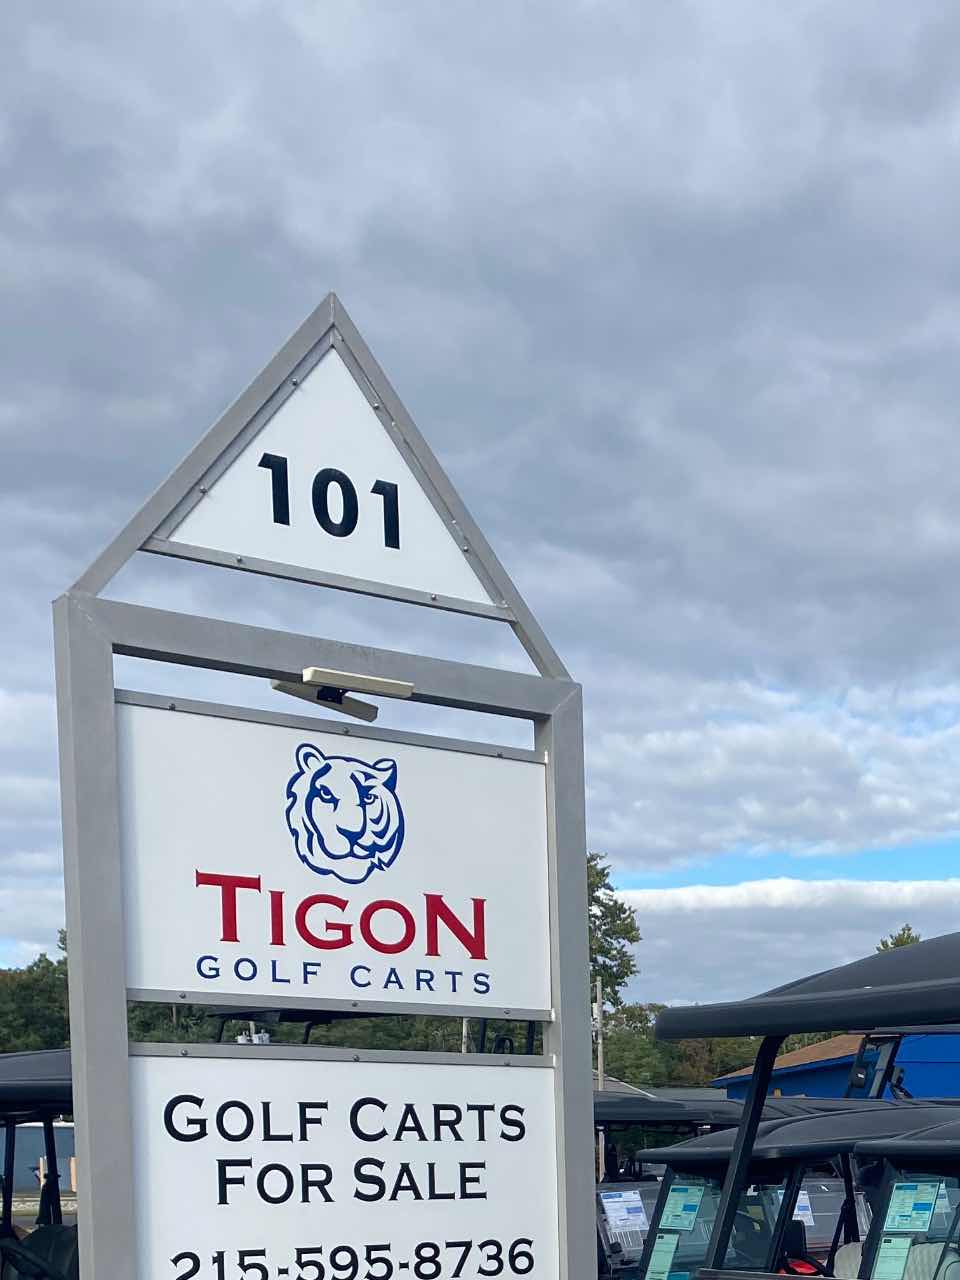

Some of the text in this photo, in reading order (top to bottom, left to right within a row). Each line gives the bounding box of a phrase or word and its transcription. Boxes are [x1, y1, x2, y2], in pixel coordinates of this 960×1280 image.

[258, 453, 401, 550] 101
[195, 868, 489, 961] TIGON
[196, 955, 491, 995] GOLF CARTS
[163, 1094, 526, 1143] GOLF CARTS
[216, 1157, 488, 1206] FOR SALE
